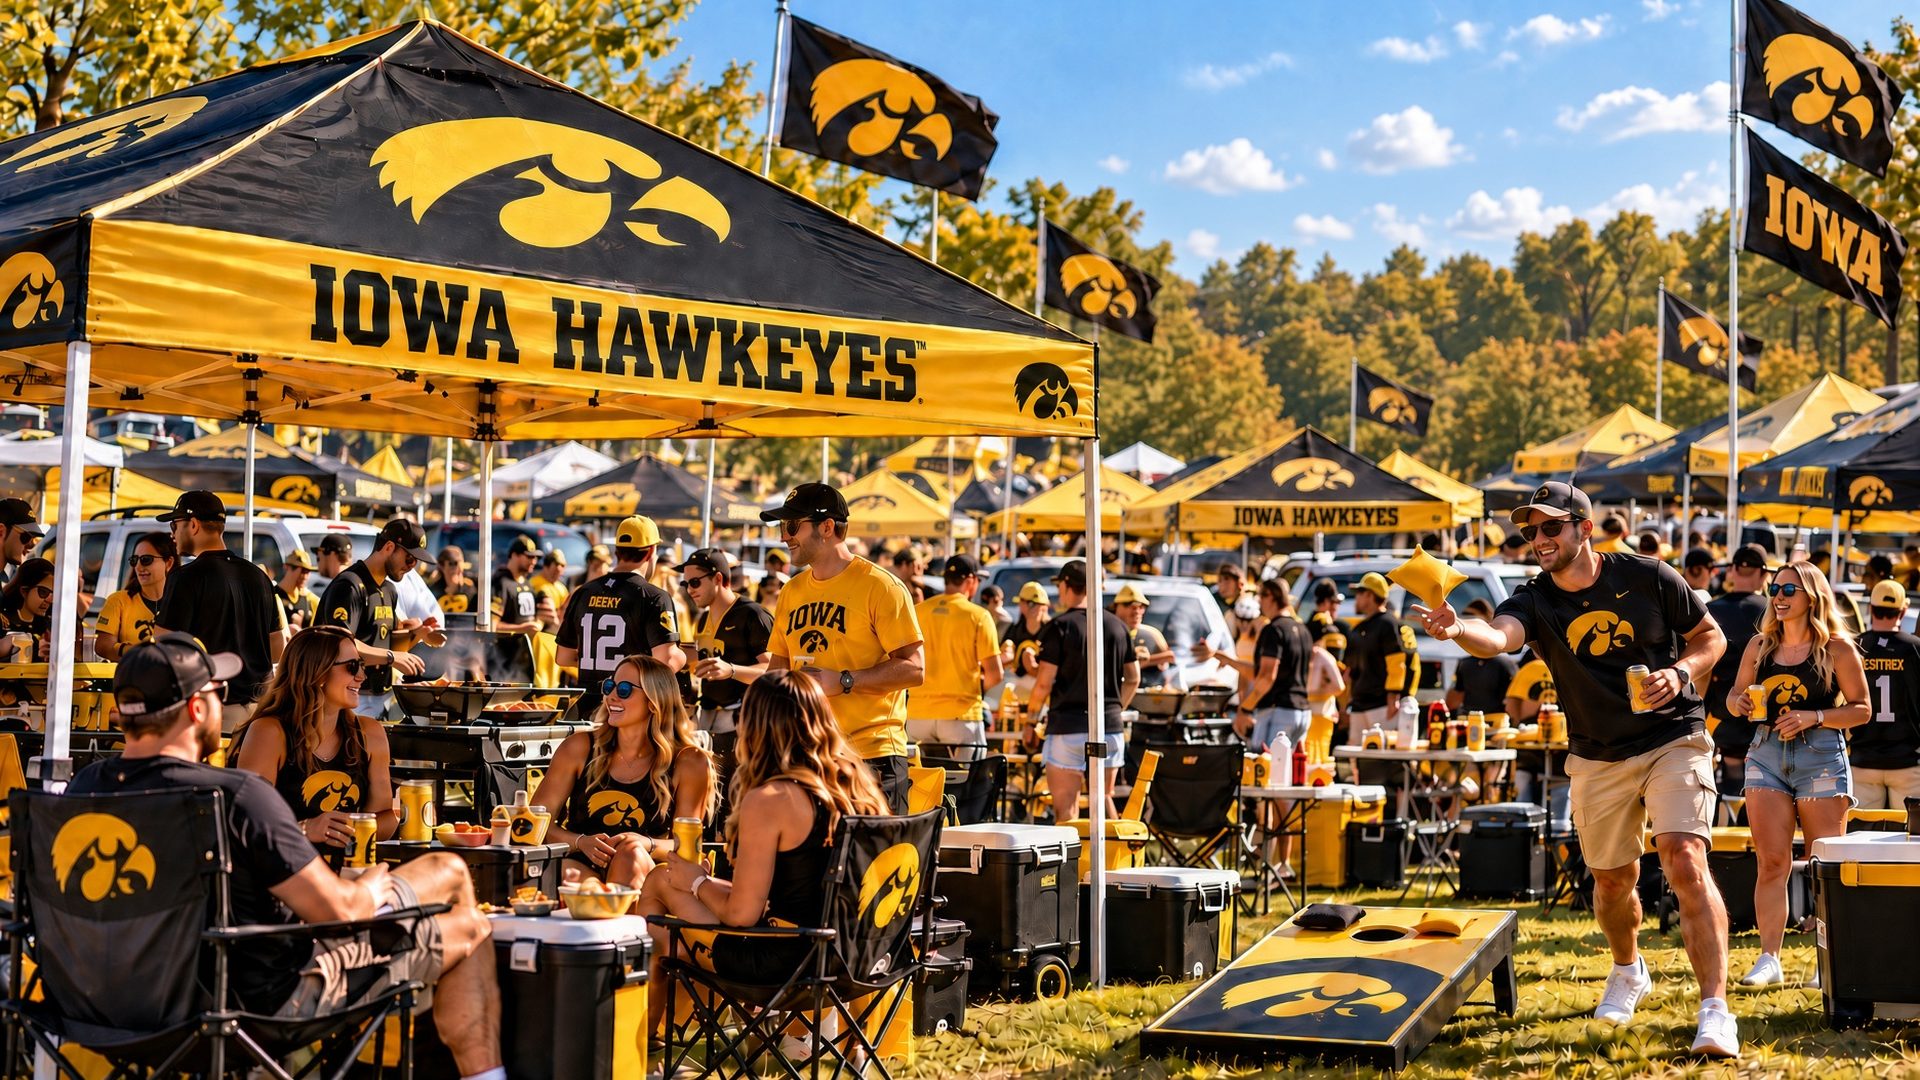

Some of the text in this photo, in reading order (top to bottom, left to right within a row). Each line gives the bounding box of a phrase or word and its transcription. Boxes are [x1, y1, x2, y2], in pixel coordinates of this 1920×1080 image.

[1765, 173, 1884, 297] IOWA
[310, 263, 520, 364] IOWA
[552, 297, 917, 403] HAWKEYES
[1233, 507, 1399, 527] IOWA HAWKEYES
[588, 596, 622, 609] DEEKY
[786, 601, 846, 636] IOWA
[580, 613, 626, 671] 12
[1875, 674, 1895, 722] 1
